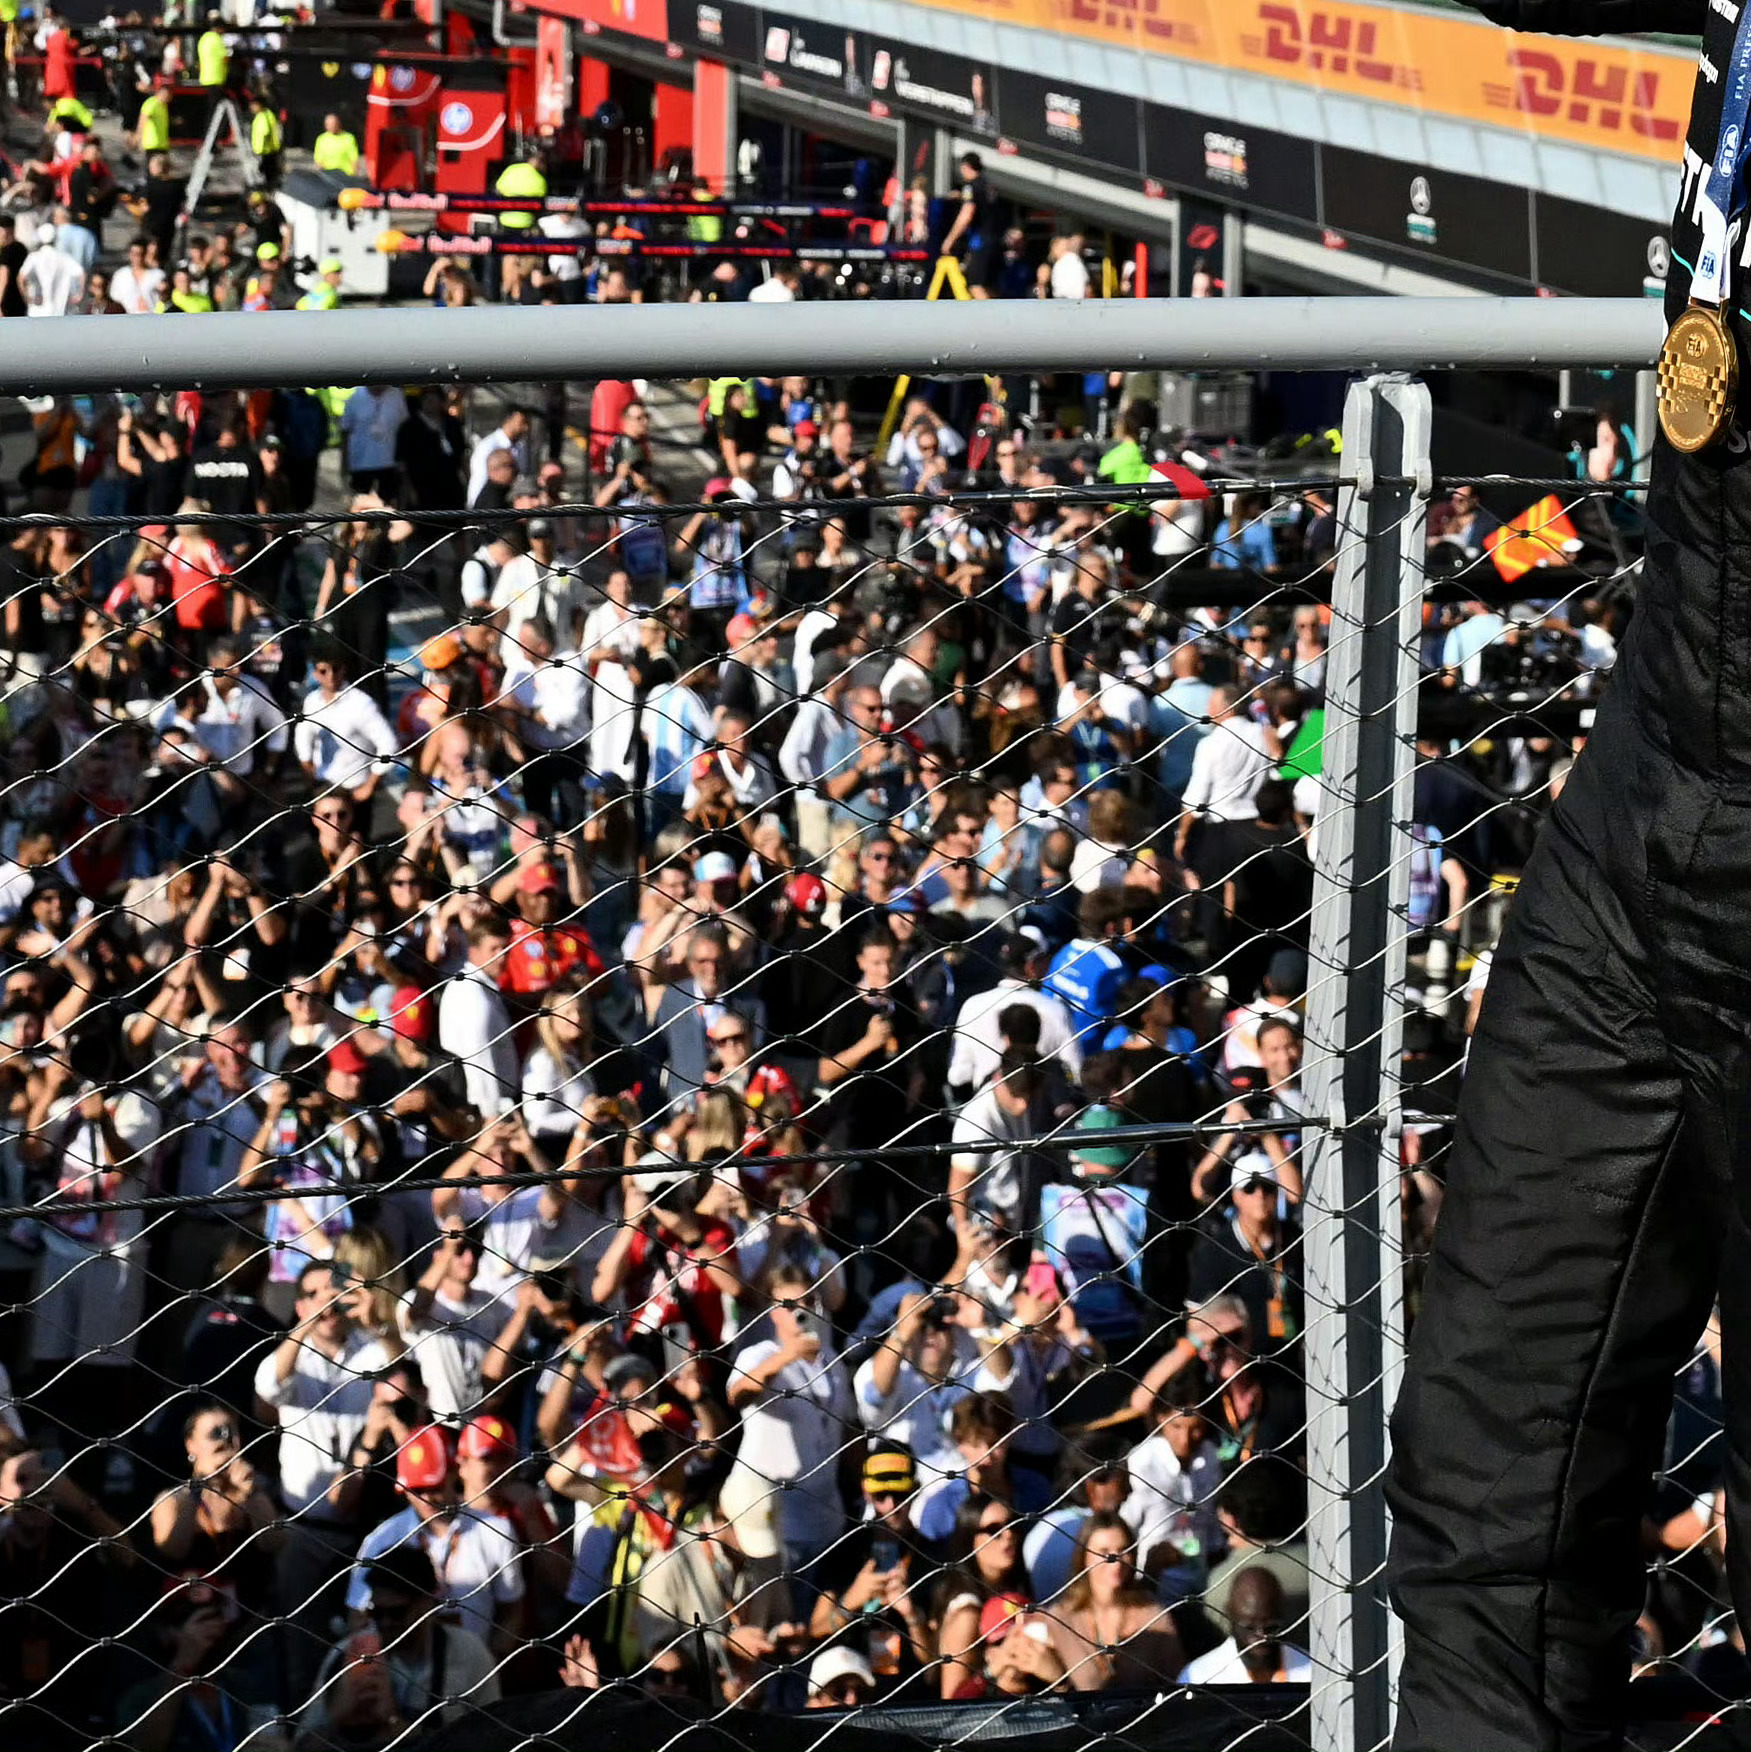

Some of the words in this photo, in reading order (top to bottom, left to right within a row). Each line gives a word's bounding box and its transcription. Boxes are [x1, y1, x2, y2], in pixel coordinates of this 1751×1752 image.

[1257, 3, 1393, 82] DHL
[1512, 48, 1679, 141] DHL
[1734, 74, 1745, 100] FIA
